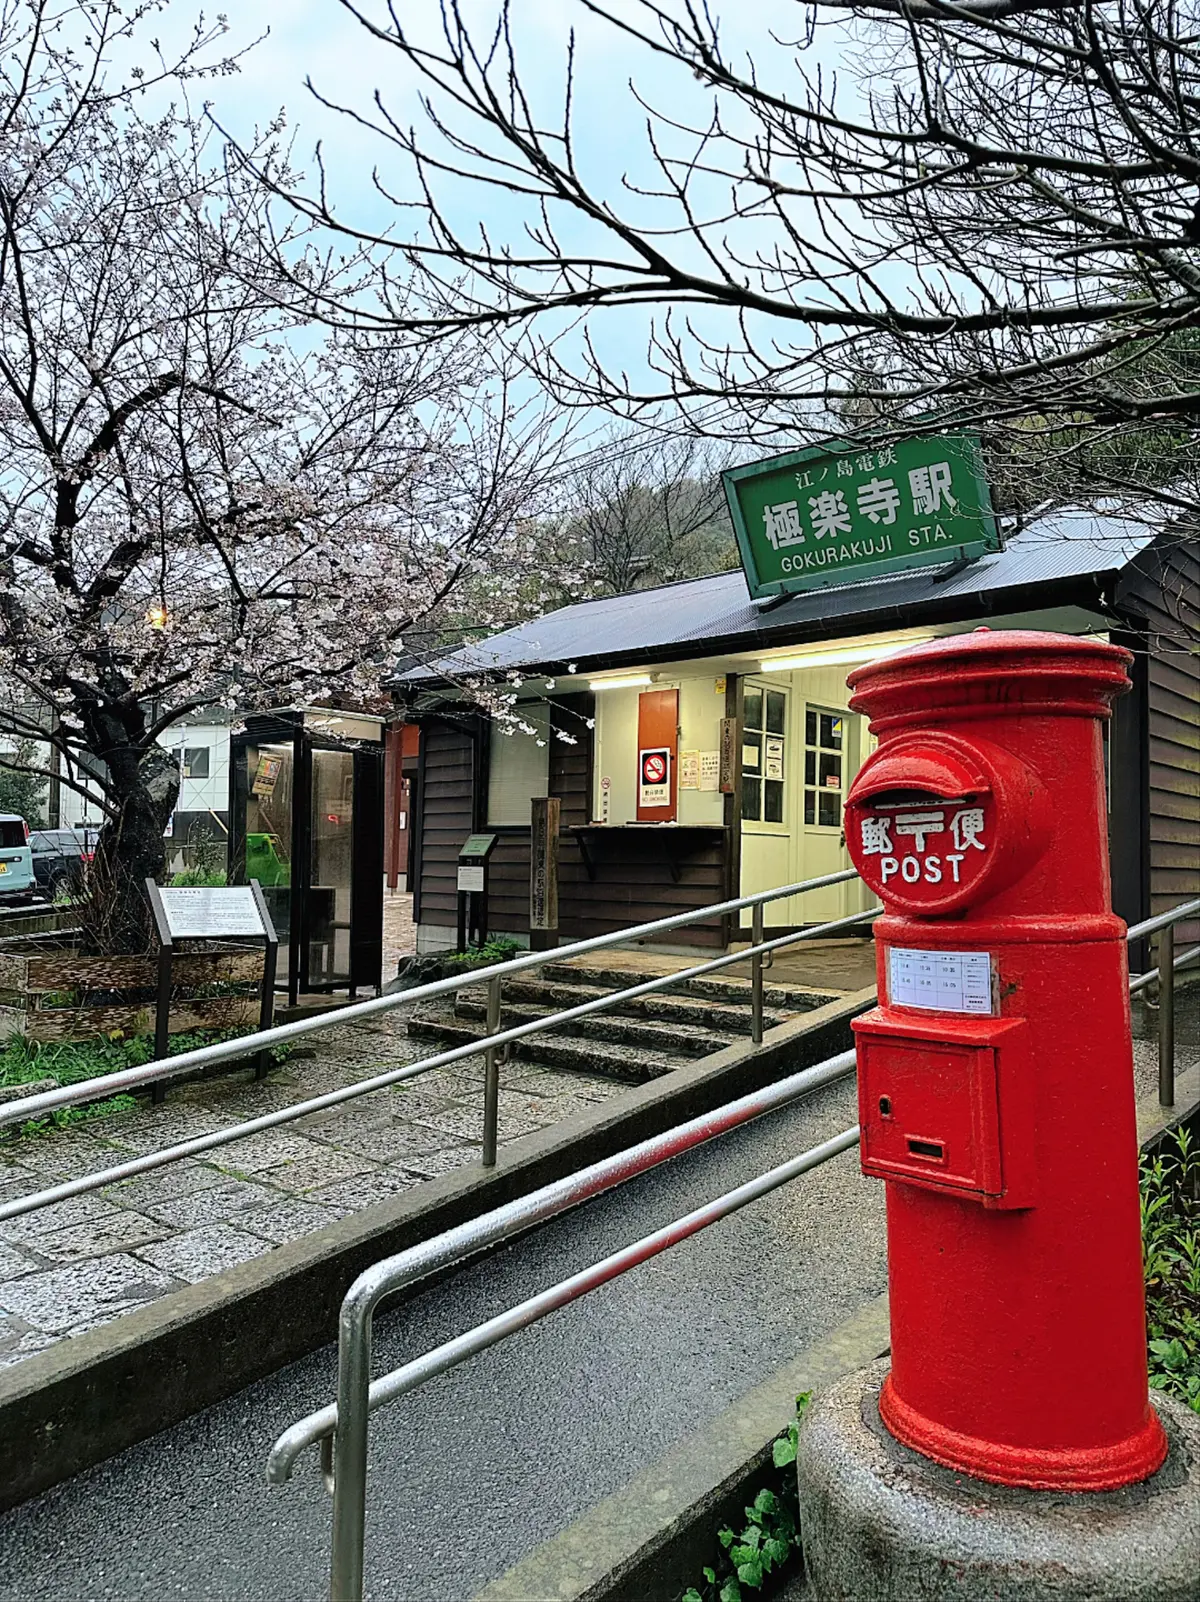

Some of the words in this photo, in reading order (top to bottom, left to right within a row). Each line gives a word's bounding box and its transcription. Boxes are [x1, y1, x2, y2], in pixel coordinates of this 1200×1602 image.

[795, 450, 899, 490] 江ノ島電鉄
[762, 461, 958, 551] 極楽寺駅
[780, 535, 893, 573] GOKURAKUJI
[908, 523, 954, 547] STA.
[880, 854, 965, 884] POST
